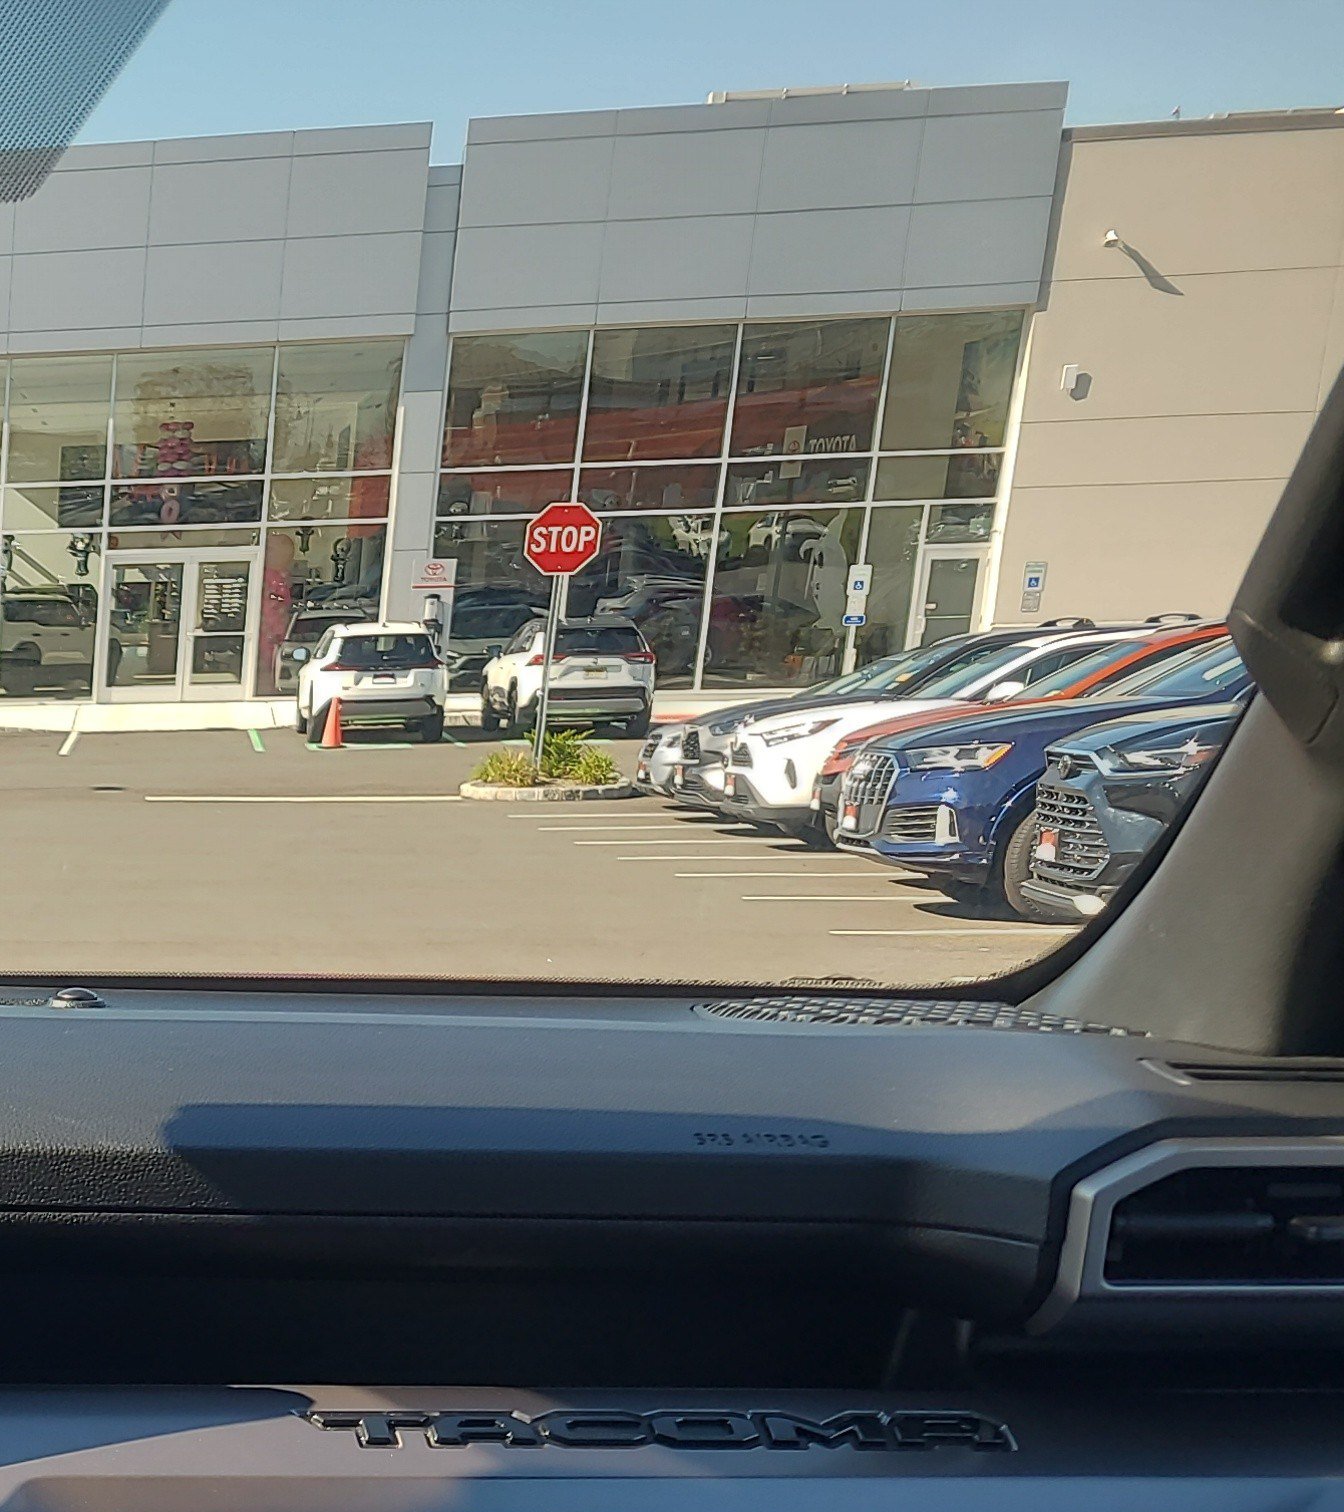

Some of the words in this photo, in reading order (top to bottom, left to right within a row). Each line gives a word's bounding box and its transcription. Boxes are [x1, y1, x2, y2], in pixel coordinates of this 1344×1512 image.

[809, 434, 857, 453] TOYOTA
[530, 525, 596, 553] STOP
[312, 1410, 1018, 1450] TACOMA
